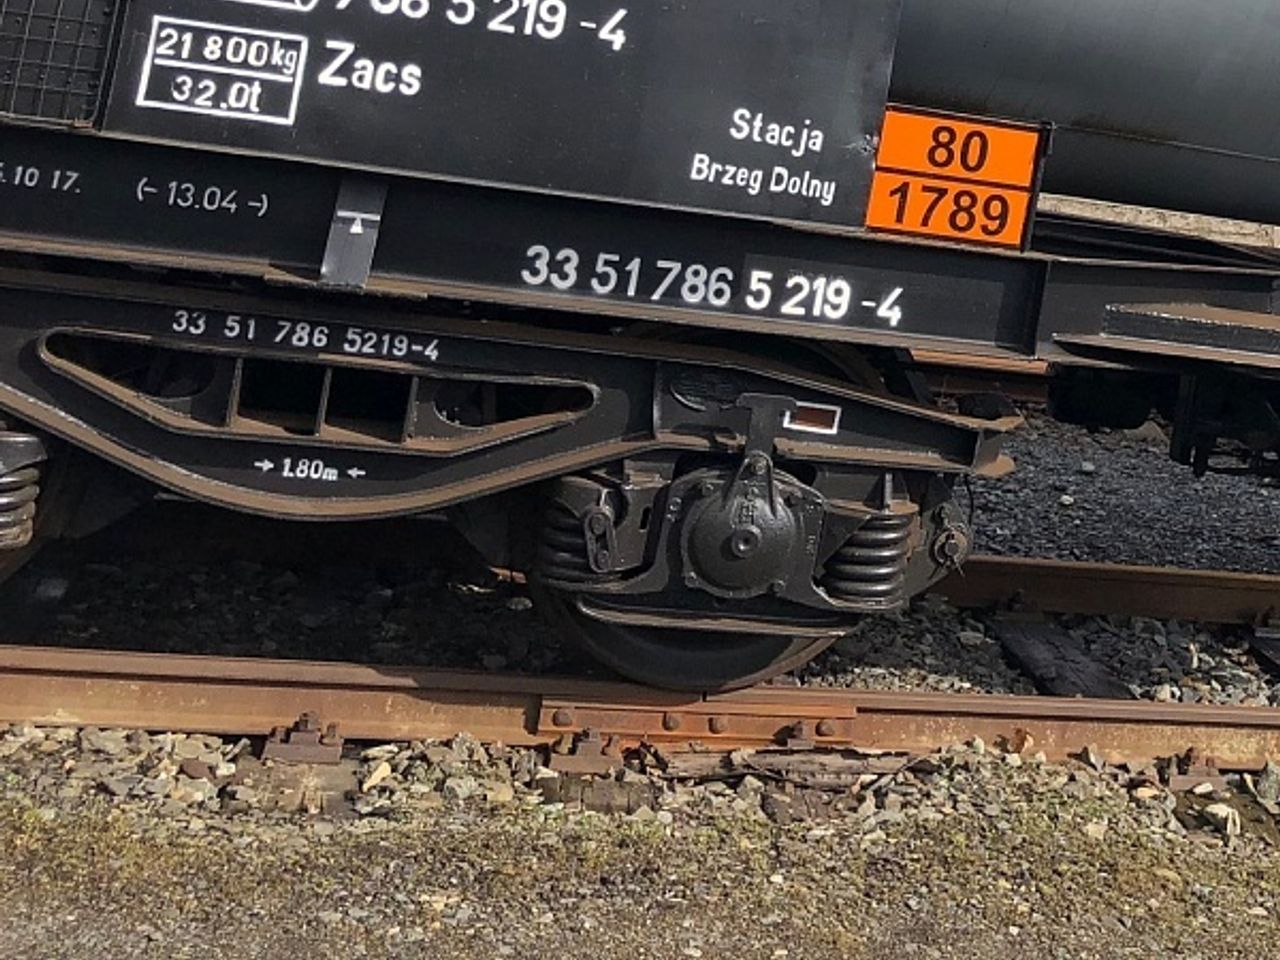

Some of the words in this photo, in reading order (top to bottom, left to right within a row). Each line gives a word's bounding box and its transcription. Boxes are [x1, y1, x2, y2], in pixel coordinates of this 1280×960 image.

[317, 39, 422, 96] Zacs
[729, 107, 824, 158] Stacja
[927, 125, 989, 173] 80
[689, 152, 764, 196] Brzeg
[769, 165, 836, 207] Dolny
[888, 181, 1010, 236] 1789
[521, 244, 579, 290] 33
[590, 253, 641, 298] 51
[650, 260, 733, 307] 786
[745, 269, 773, 311] 5
[781, 275, 851, 319] 219
[172, 309, 206, 335] 33
[223, 315, 256, 340] 51
[273, 321, 329, 348] 786
